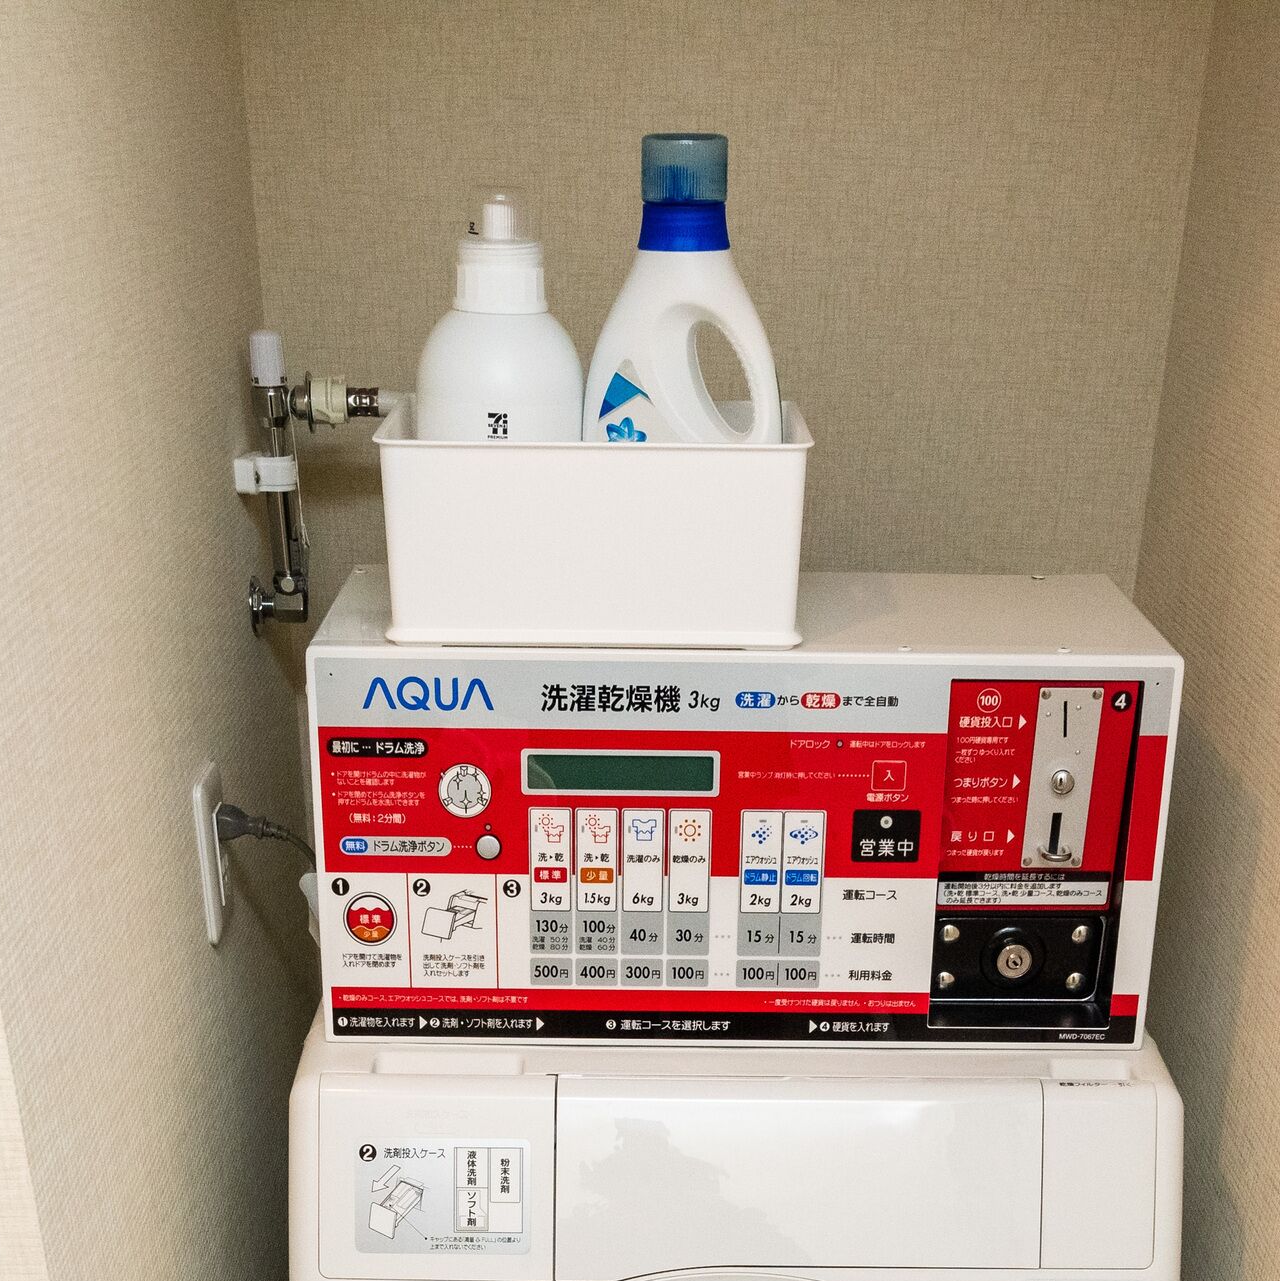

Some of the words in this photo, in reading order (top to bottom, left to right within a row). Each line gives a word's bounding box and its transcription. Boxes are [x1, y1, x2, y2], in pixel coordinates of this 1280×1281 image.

[363, 676, 494, 711] AQUA
[540, 684, 681, 713] 洗濯乾燥機
[688, 690, 721, 712] 3kg
[980, 695, 999, 707] 100
[959, 716, 1013, 729] 硬貨投入口
[332, 741, 360, 754] 最初に
[375, 742, 425, 755] ドラム洗浄
[790, 739, 831, 749] ドアロック
[850, 740, 926, 749] 運転中はドアをロックします
[955, 756, 976, 764] ください
[336, 770, 427, 779] ドアを開けドラムの中に洗濯物が
[883, 769, 895, 782] 入
[337, 778, 395, 786] ないことを確認します
[953, 777, 1008, 789] つまりボタン
[337, 790, 426, 800] ドアを閉めてドラム洗浄ボタンを
[866, 793, 909, 803] 電源ボタン
[951, 796, 1019, 804] つまった時に押してください
[338, 799, 420, 807] 押すとドラムを水洗いできます
[951, 830, 995, 842] 戻り口
[345, 840, 366, 852] 無料
[373, 840, 445, 853] ドラム洗浄ボタン
[860, 838, 914, 857] 営業中
[626, 854, 661, 864] 洗濯のみ
[672, 854, 706, 864] 乾燥のみ
[946, 849, 1005, 857] つまった硬貨が戻ります
[745, 855, 777, 865] エアウォッシュ
[787, 855, 819, 865] エアウォッシュ
[540, 870, 562, 881] 標準
[586, 870, 609, 881] 少量
[744, 871, 776, 882] ドラム静止
[786, 872, 818, 883] ドラム回転
[983, 873, 1065, 881] 乾燥時間を延長するには
[943, 882, 1062, 890] 運転開始後3分以内に料金を追加します
[540, 893, 563, 905] 3kg
[584, 893, 611, 905] 1.5kg
[632, 893, 655, 906] 6kg
[677, 893, 699, 906] 3kg
[750, 893, 771, 907] 2kg
[790, 893, 812, 907] 2kg
[842, 889, 898, 901] 運転コース
[359, 914, 381, 924] 標準
[535, 920, 569, 933] 130分
[582, 920, 616, 933] 100分
[532, 936, 546, 944] 洗濯
[550, 936, 569, 944] 50分
[579, 936, 593, 944] 洗濯
[597, 936, 616, 944] 40分
[629, 928, 658, 942] 40分
[675, 928, 704, 943] 30分
[746, 930, 775, 944] 15分
[789, 930, 818, 944] 15分
[850, 932, 896, 944] 運転時間
[532, 943, 546, 951] 乾燥
[549, 943, 569, 951] 80分
[579, 943, 593, 951] 乾燥
[597, 943, 616, 951] 60分
[342, 953, 402, 961] ドアを開けて洗濯物を
[423, 954, 485, 962] 洗剤投入ケースを引き
[343, 960, 396, 968] 入れドアを閉めます
[423, 969, 469, 977] 入れセットします
[533, 966, 569, 979] 500円
[580, 966, 616, 979] 400円
[625, 966, 661, 979] 300円
[672, 966, 705, 980] 100円
[742, 967, 775, 980] 100円
[785, 968, 817, 981] 100円
[848, 970, 893, 981] 利用料金
[350, 1016, 416, 1028] 洗濯物を入れます
[442, 1017, 533, 1029] 洗剤・ソフト剤を入れます
[620, 1019, 731, 1031] 運転コースを選択します
[832, 1021, 890, 1032] 硬貨を入れます
[1058, 1032, 1106, 1040] MWD-7067EC
[383, 1148, 446, 1159] 洗剤投入ケース
[467, 1150, 478, 1186] 液体洗剤
[500, 1158, 511, 1194] 粉末洗剤
[467, 1191, 478, 1227] ソフト剤
